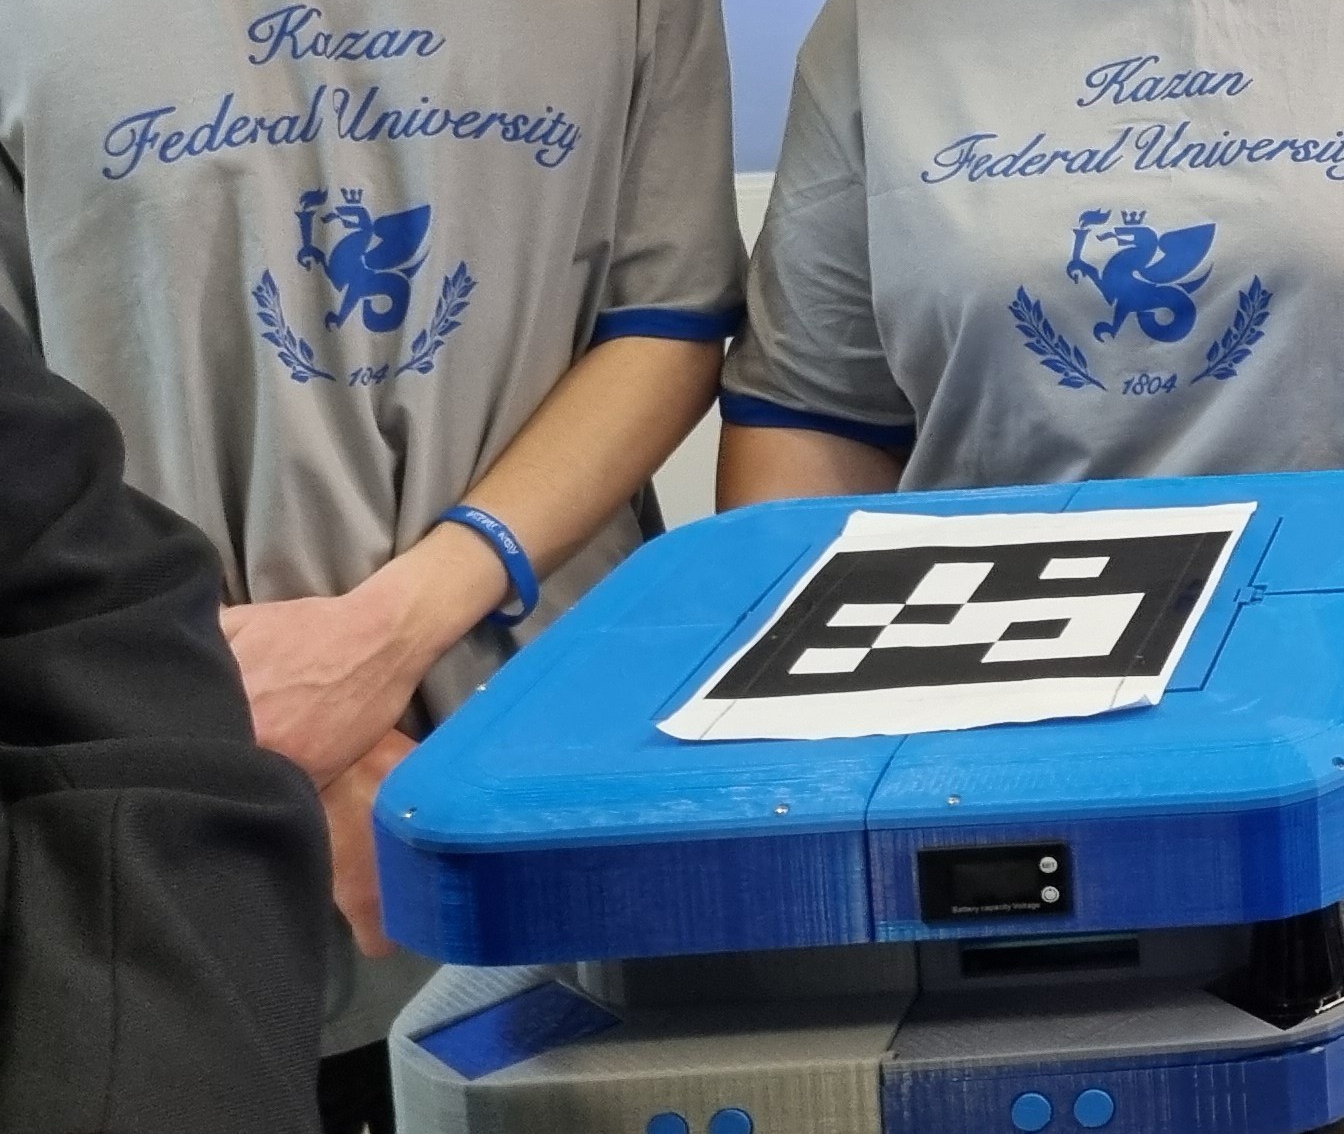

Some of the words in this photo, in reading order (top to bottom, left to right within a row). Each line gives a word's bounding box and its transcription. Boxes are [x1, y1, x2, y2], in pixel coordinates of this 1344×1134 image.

[247, 3, 446, 66] Kazan
[1076, 54, 1252, 109] Kazan
[101, 84, 327, 180] Federal
[332, 85, 582, 170] University
[921, 127, 1132, 185] Federal
[1120, 372, 1179, 396] 1804
